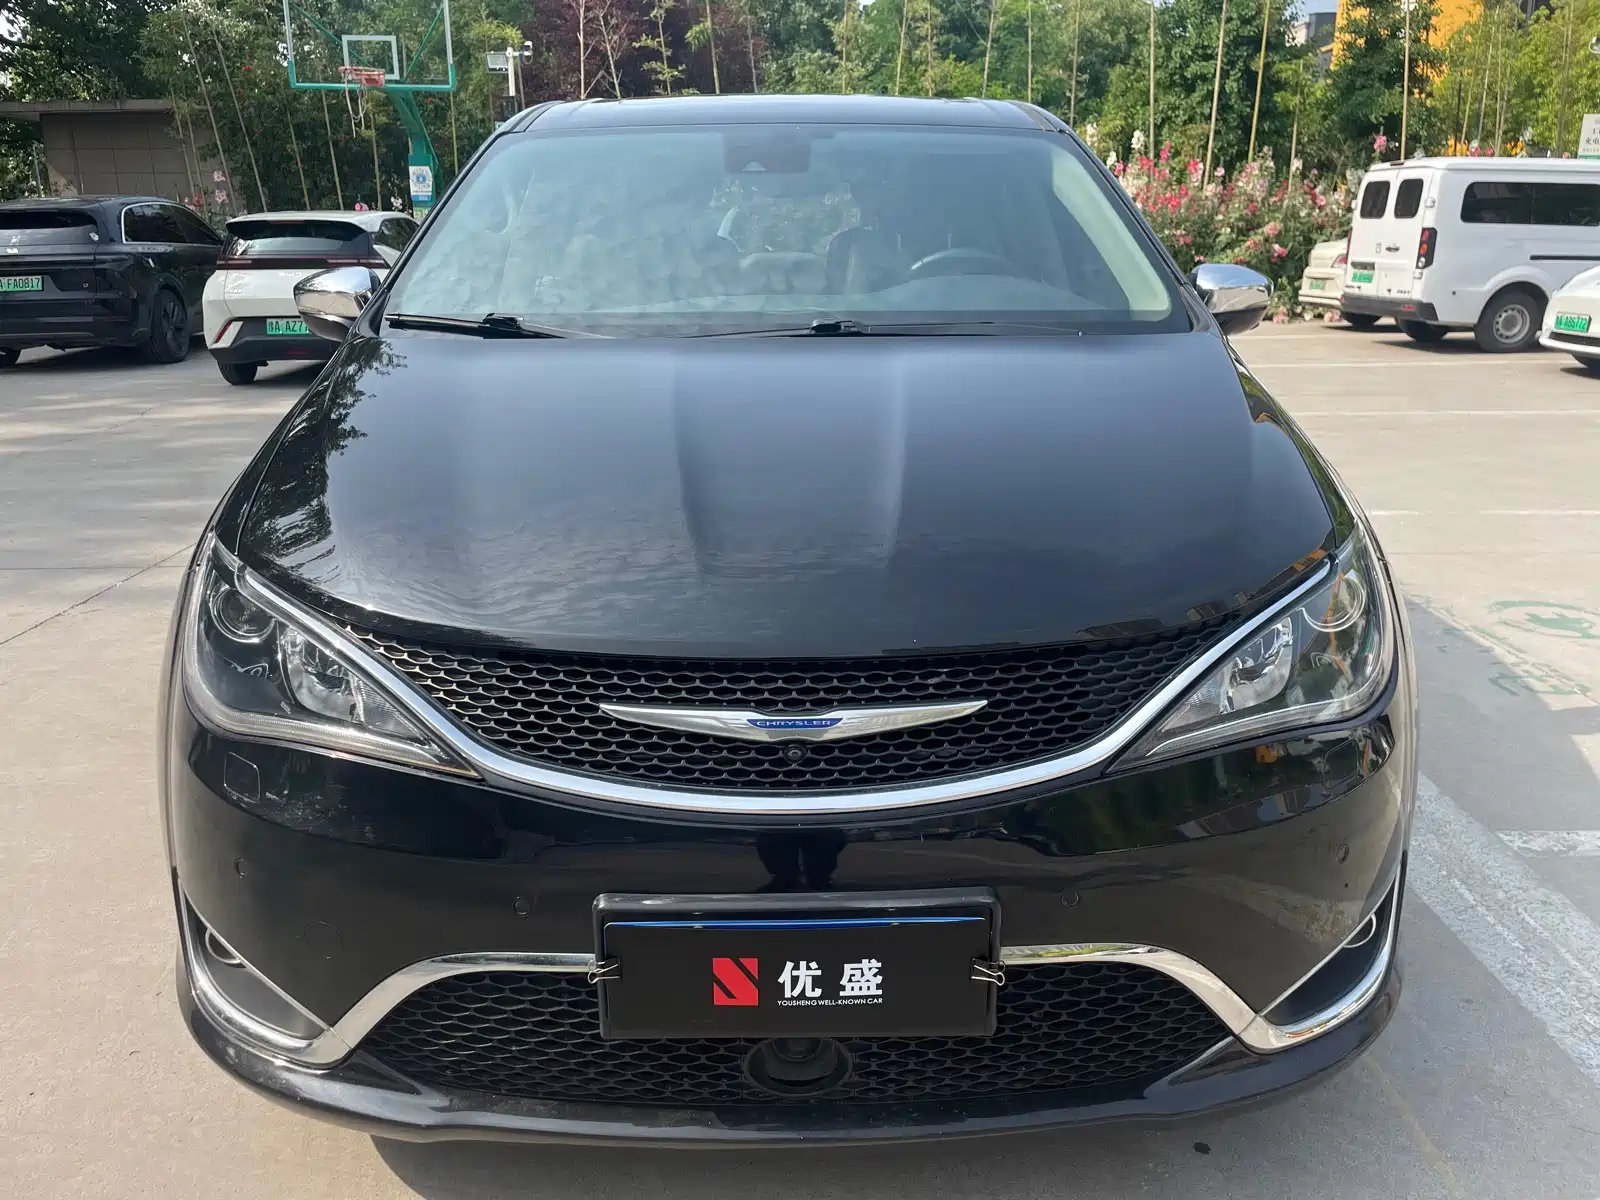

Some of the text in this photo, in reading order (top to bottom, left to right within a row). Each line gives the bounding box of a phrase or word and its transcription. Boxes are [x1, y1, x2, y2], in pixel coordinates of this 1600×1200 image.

[7, 277, 40, 289] FA0817
[777, 958, 883, 998] 优盛
[777, 997, 883, 1007] YOUSHENG WELL-KNOWN CAR
